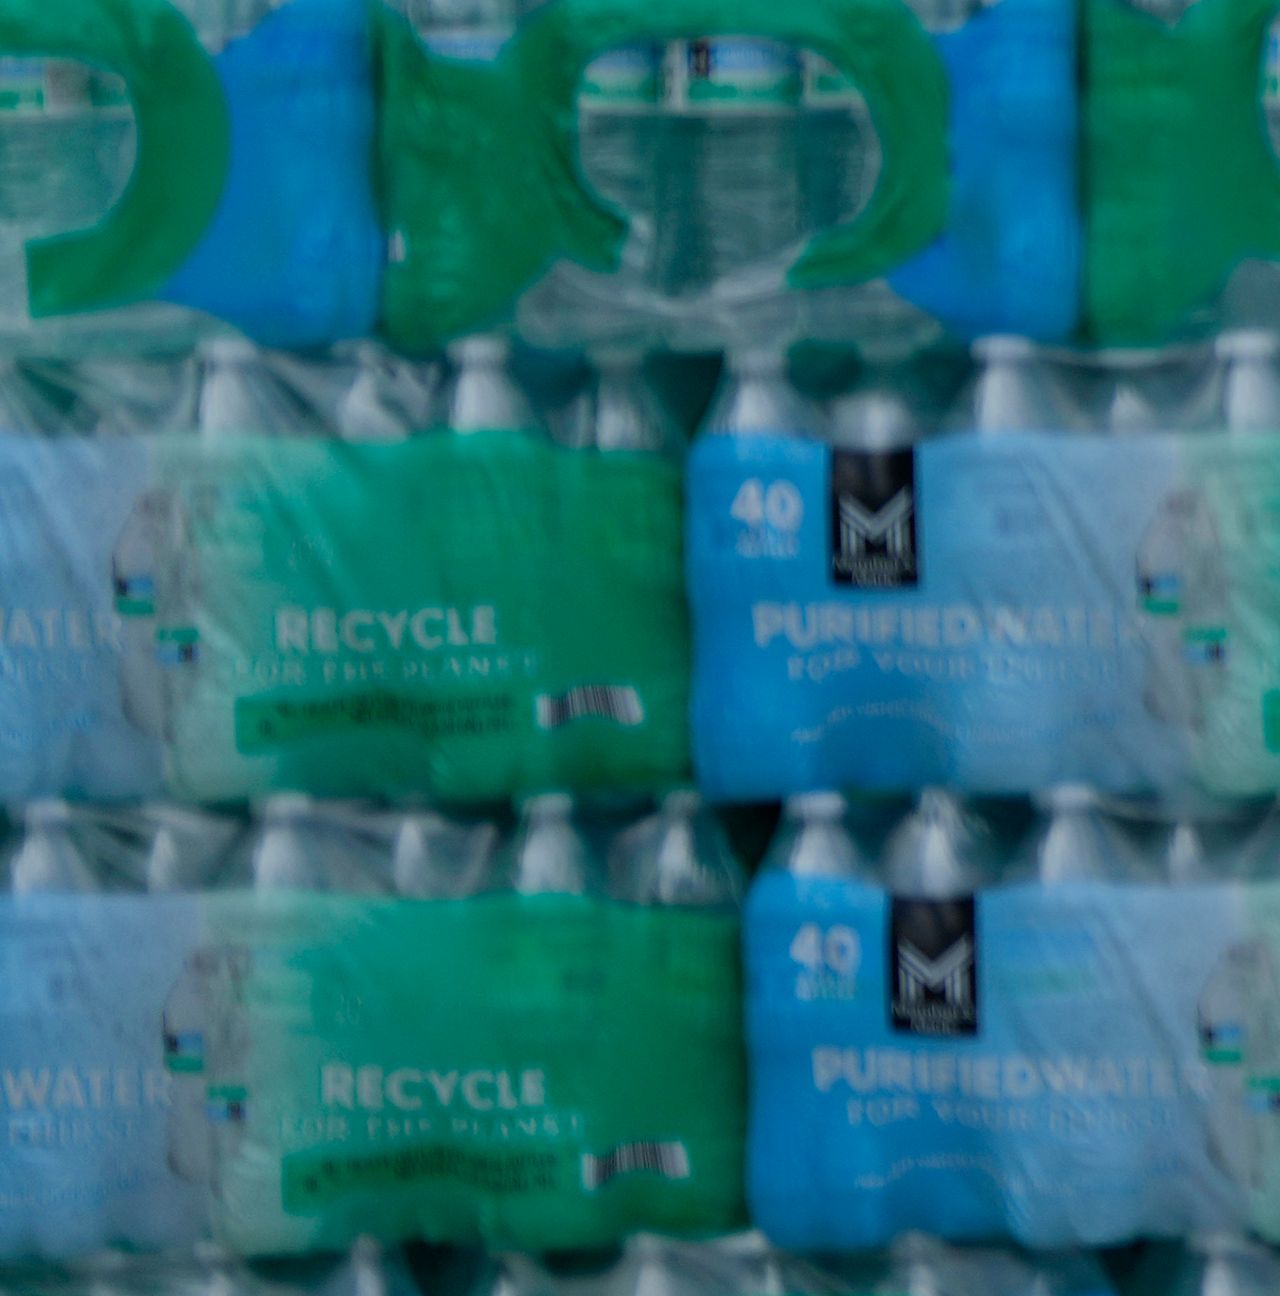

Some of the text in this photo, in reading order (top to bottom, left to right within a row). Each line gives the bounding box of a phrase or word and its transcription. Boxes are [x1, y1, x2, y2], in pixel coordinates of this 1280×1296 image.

[731, 478, 805, 530] 40
[276, 604, 498, 654] RECYCLE
[752, 604, 982, 648] PURIFIED
[788, 924, 861, 973] 40
[3, 1066, 172, 1110] WATER
[320, 1064, 547, 1110] RECYCLE
[811, 1047, 1038, 1099] PURIFIED
